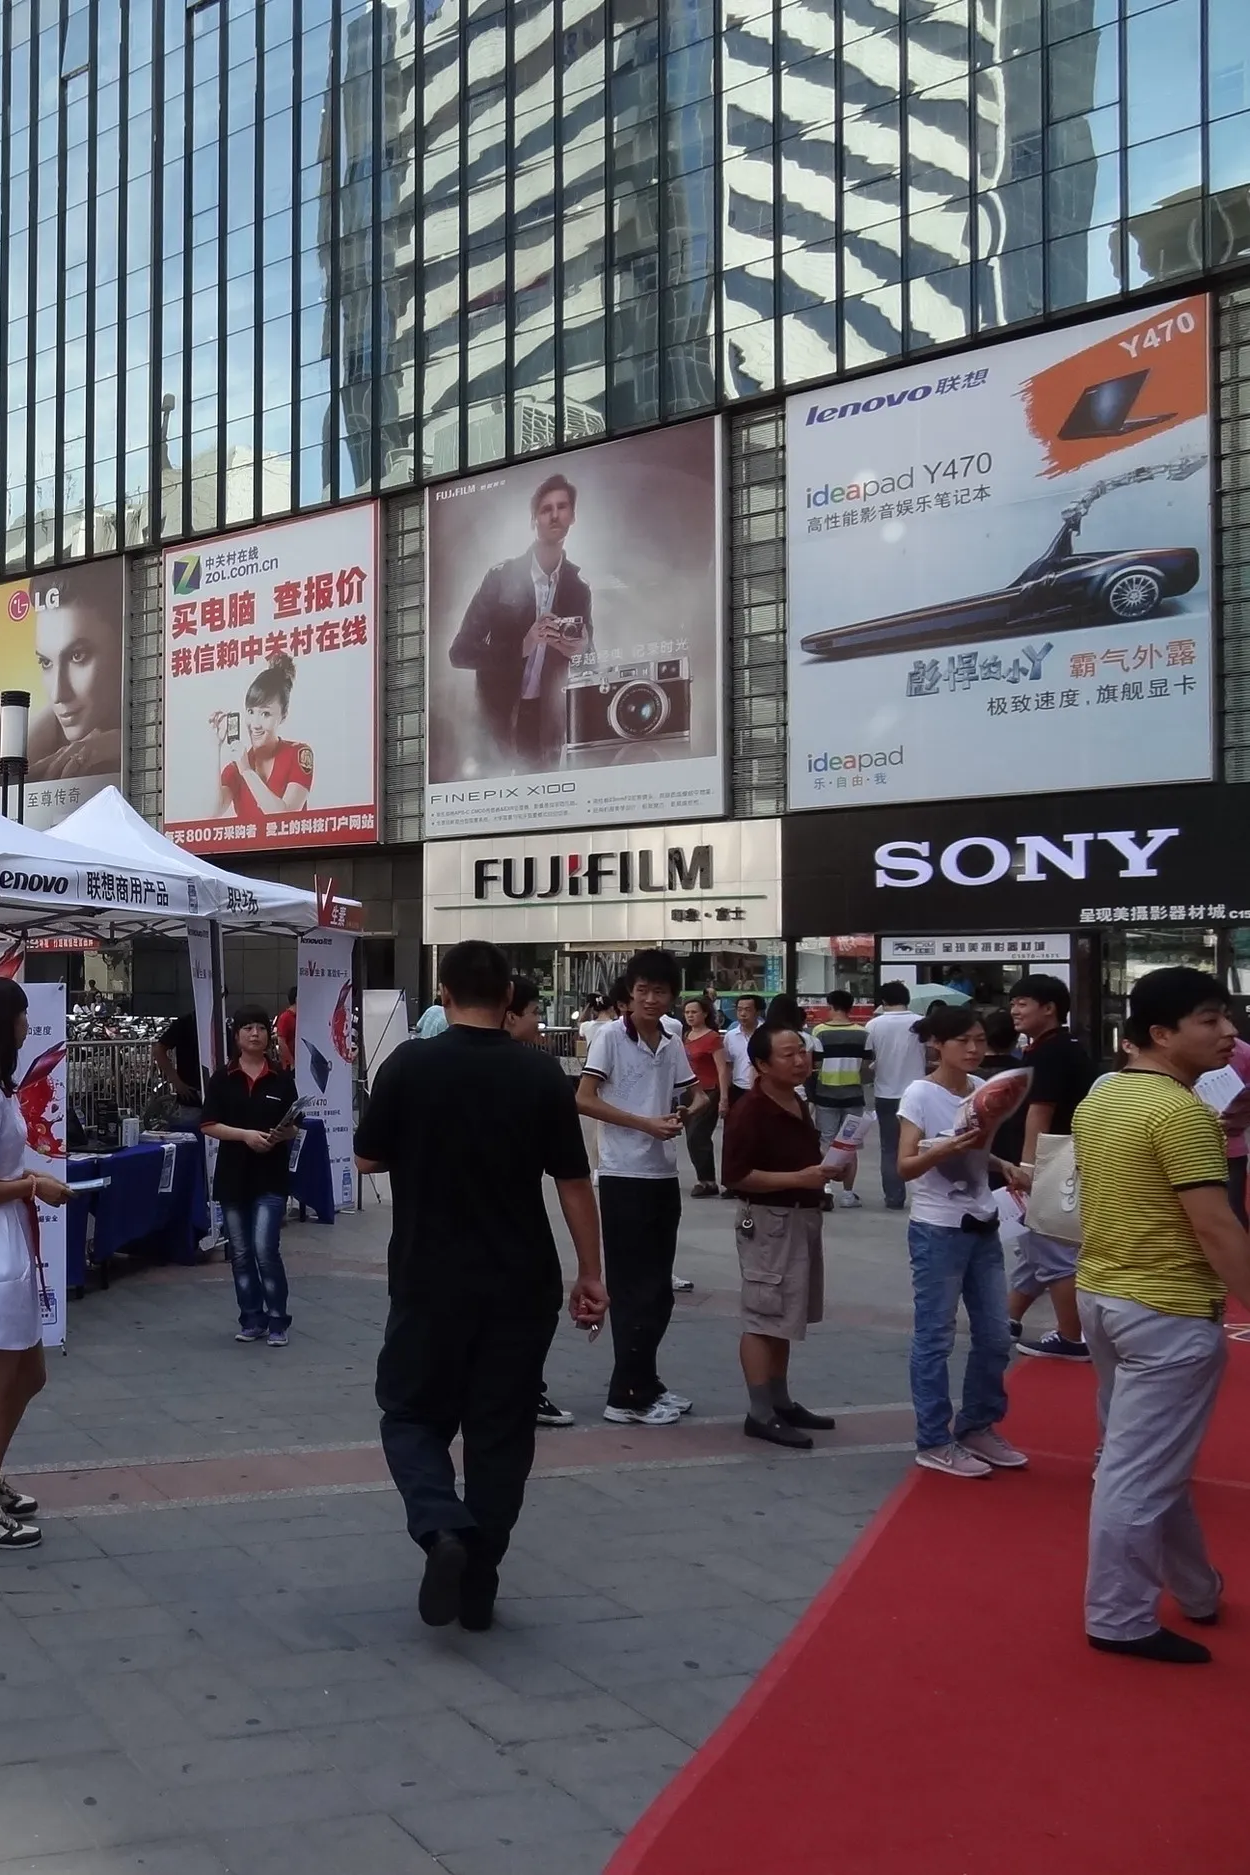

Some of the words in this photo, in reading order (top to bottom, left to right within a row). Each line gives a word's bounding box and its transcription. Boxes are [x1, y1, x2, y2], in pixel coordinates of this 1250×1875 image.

[1119, 311, 1196, 359] Y470
[805, 384, 933, 426] lenovo
[935, 368, 989, 395] 联想
[806, 466, 914, 509] ideapad
[923, 450, 993, 485] Y470
[806, 484, 991, 534] 高性能影音娱乐笔记本
[205, 546, 259, 571] 中关村在线
[34, 588, 60, 613] LG
[171, 589, 255, 640] 买电脑
[273, 565, 368, 620] 查报价
[171, 613, 368, 678] 我信赖中关村在线
[1069, 639, 1198, 680] 霸气外露
[807, 745, 904, 773] ideapad
[27, 786, 81, 809] 至尊传奇
[430, 787, 519, 805] FINEPIX
[527, 782, 576, 796] X100
[265, 813, 375, 838] 爱上的科技门户网站
[474, 844, 715, 899] FUJIFILM
[874, 828, 1180, 888] SONY
[86, 870, 169, 907] 联想商用产品
[226, 885, 260, 916] 职场
